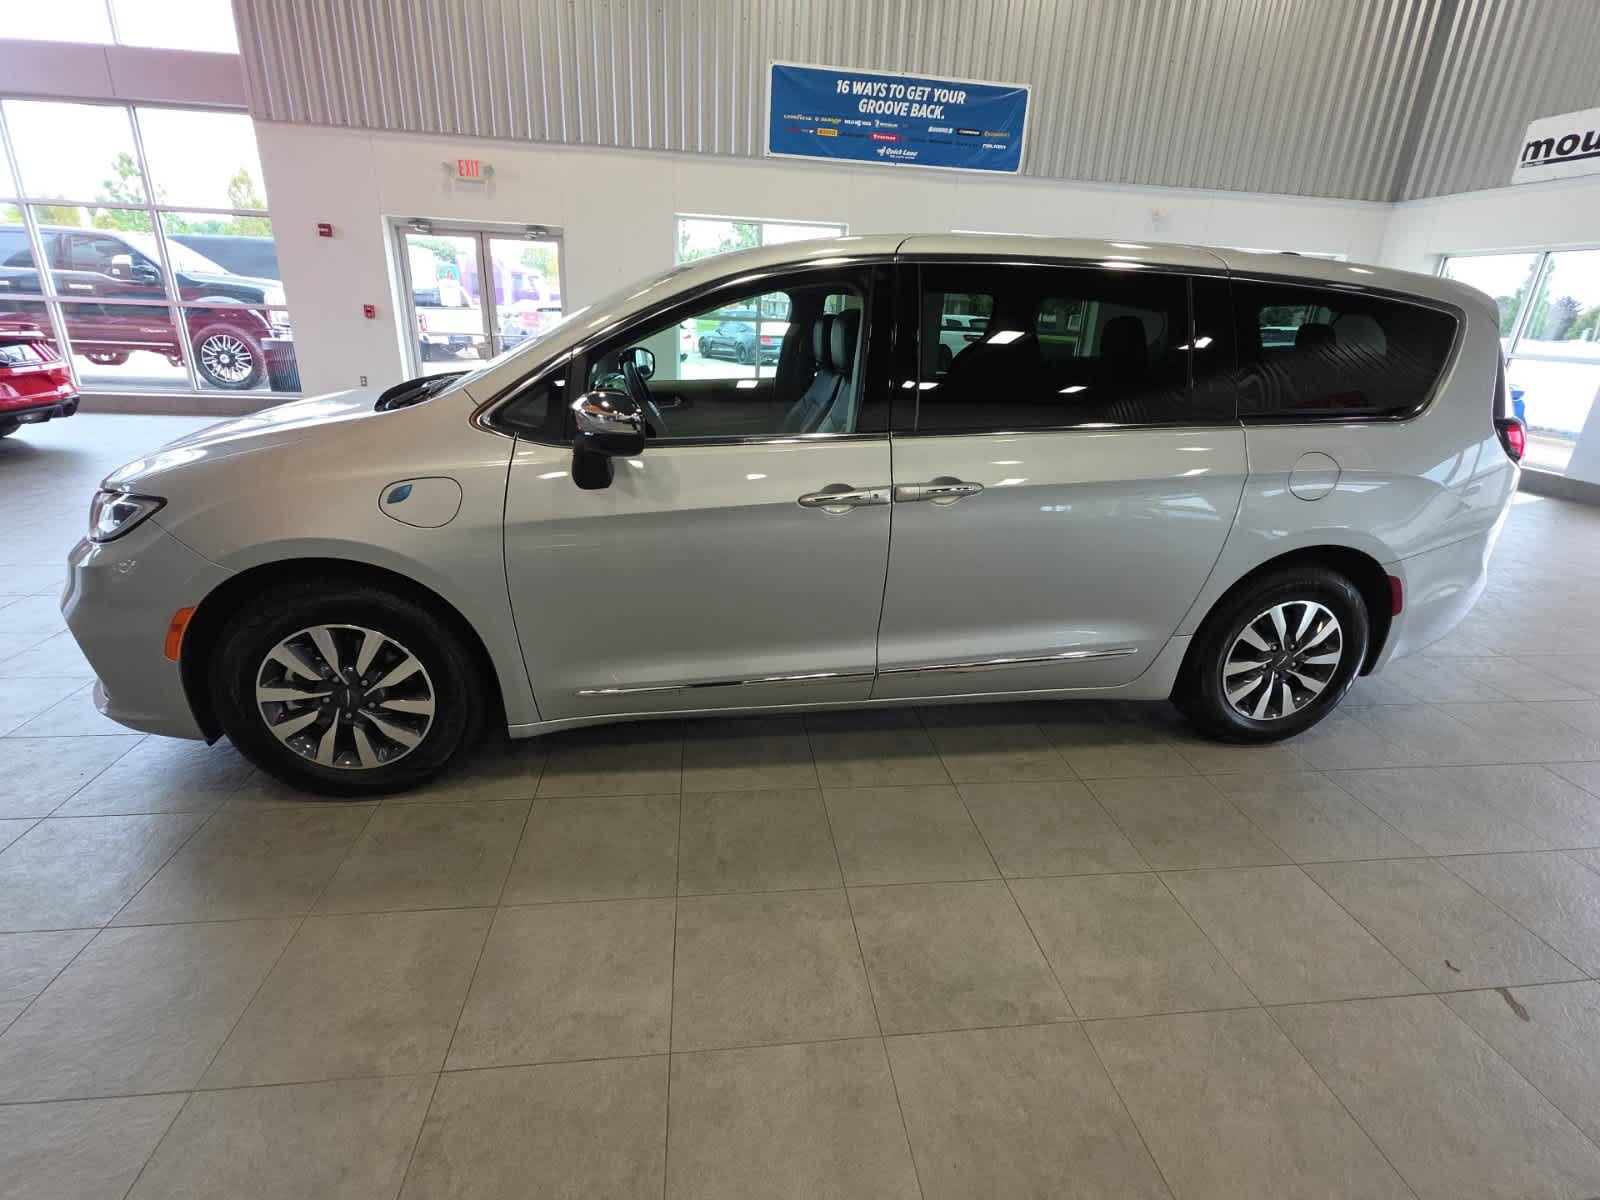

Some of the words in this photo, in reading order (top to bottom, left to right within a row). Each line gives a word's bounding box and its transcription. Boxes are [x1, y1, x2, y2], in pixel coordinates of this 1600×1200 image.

[836, 80, 850, 94] 16
[852, 81, 888, 98] WAYS
[889, 84, 905, 99] TO
[906, 86, 931, 101] GET
[933, 88, 966, 104] YOUR
[858, 99, 909, 116] GROOVE
[910, 103, 945, 119] BACK.
[457, 159, 480, 177] EXIT
